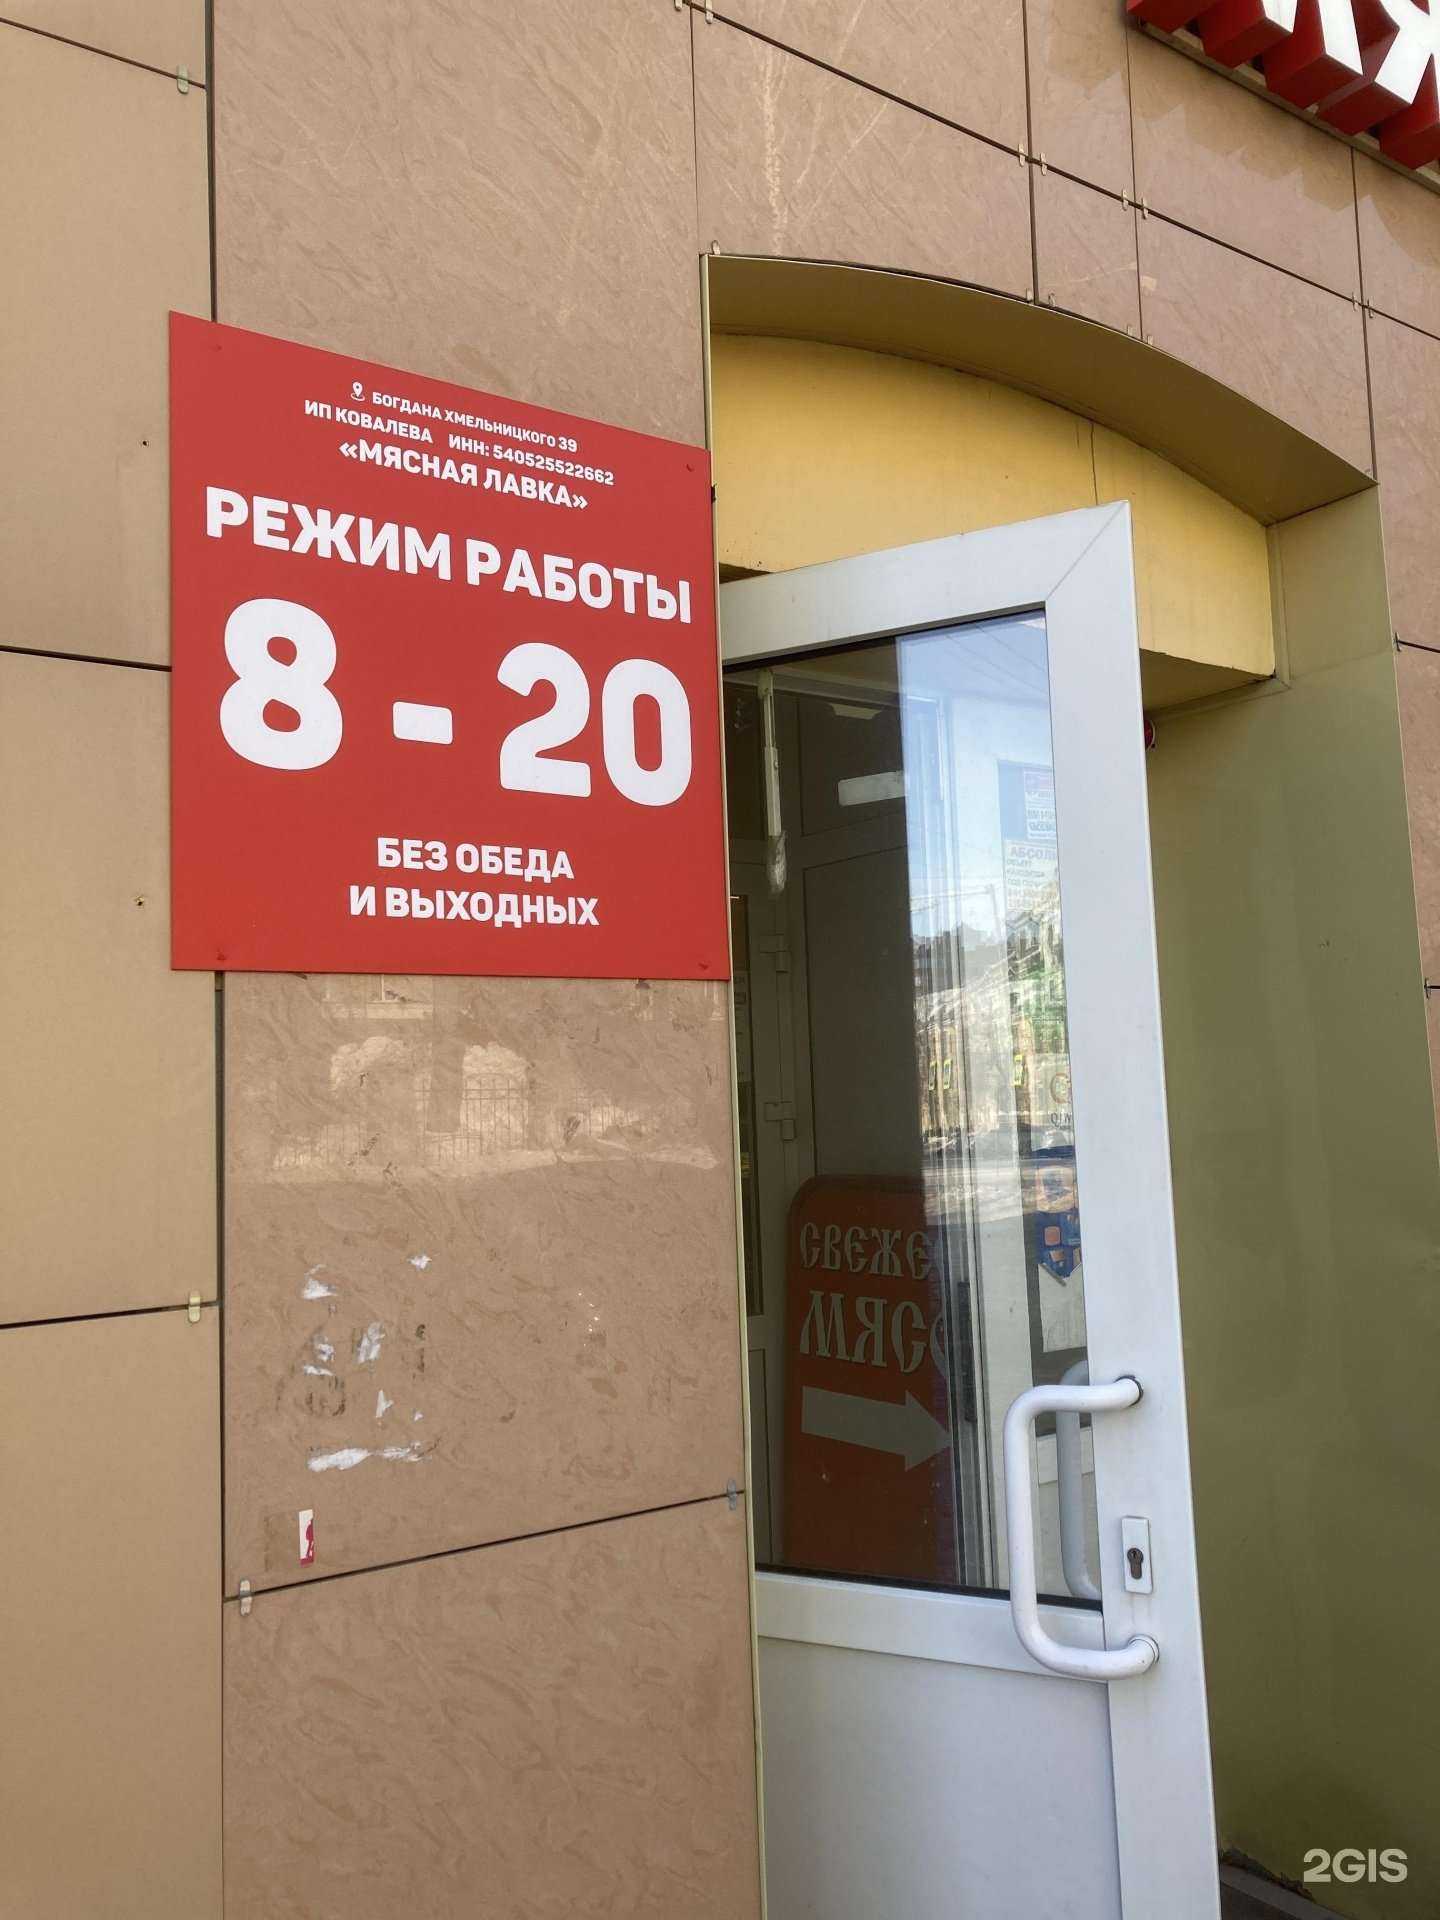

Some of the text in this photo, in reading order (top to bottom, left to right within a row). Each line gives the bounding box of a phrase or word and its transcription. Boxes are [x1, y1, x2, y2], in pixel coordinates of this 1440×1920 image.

[304, 399, 614, 486] ИП КОВАЛЕВА ИНН: 540525522662
[372, 391, 578, 453] БОГДАНА ХМЕЛЬНИЦКОГО 39
[338, 438, 589, 510] «МЯСНАЯ ЛАВКА»
[206, 486, 692, 624] РЕЖИМ РАБОТЫ
[219, 598, 343, 771] 8
[497, 642, 693, 807] 20
[377, 837, 575, 884] БЕЗ ОБЕДА
[349, 885, 600, 929] И ВЫХОДНЫХ
[800, 1222, 945, 1280] СВЕЖЕ
